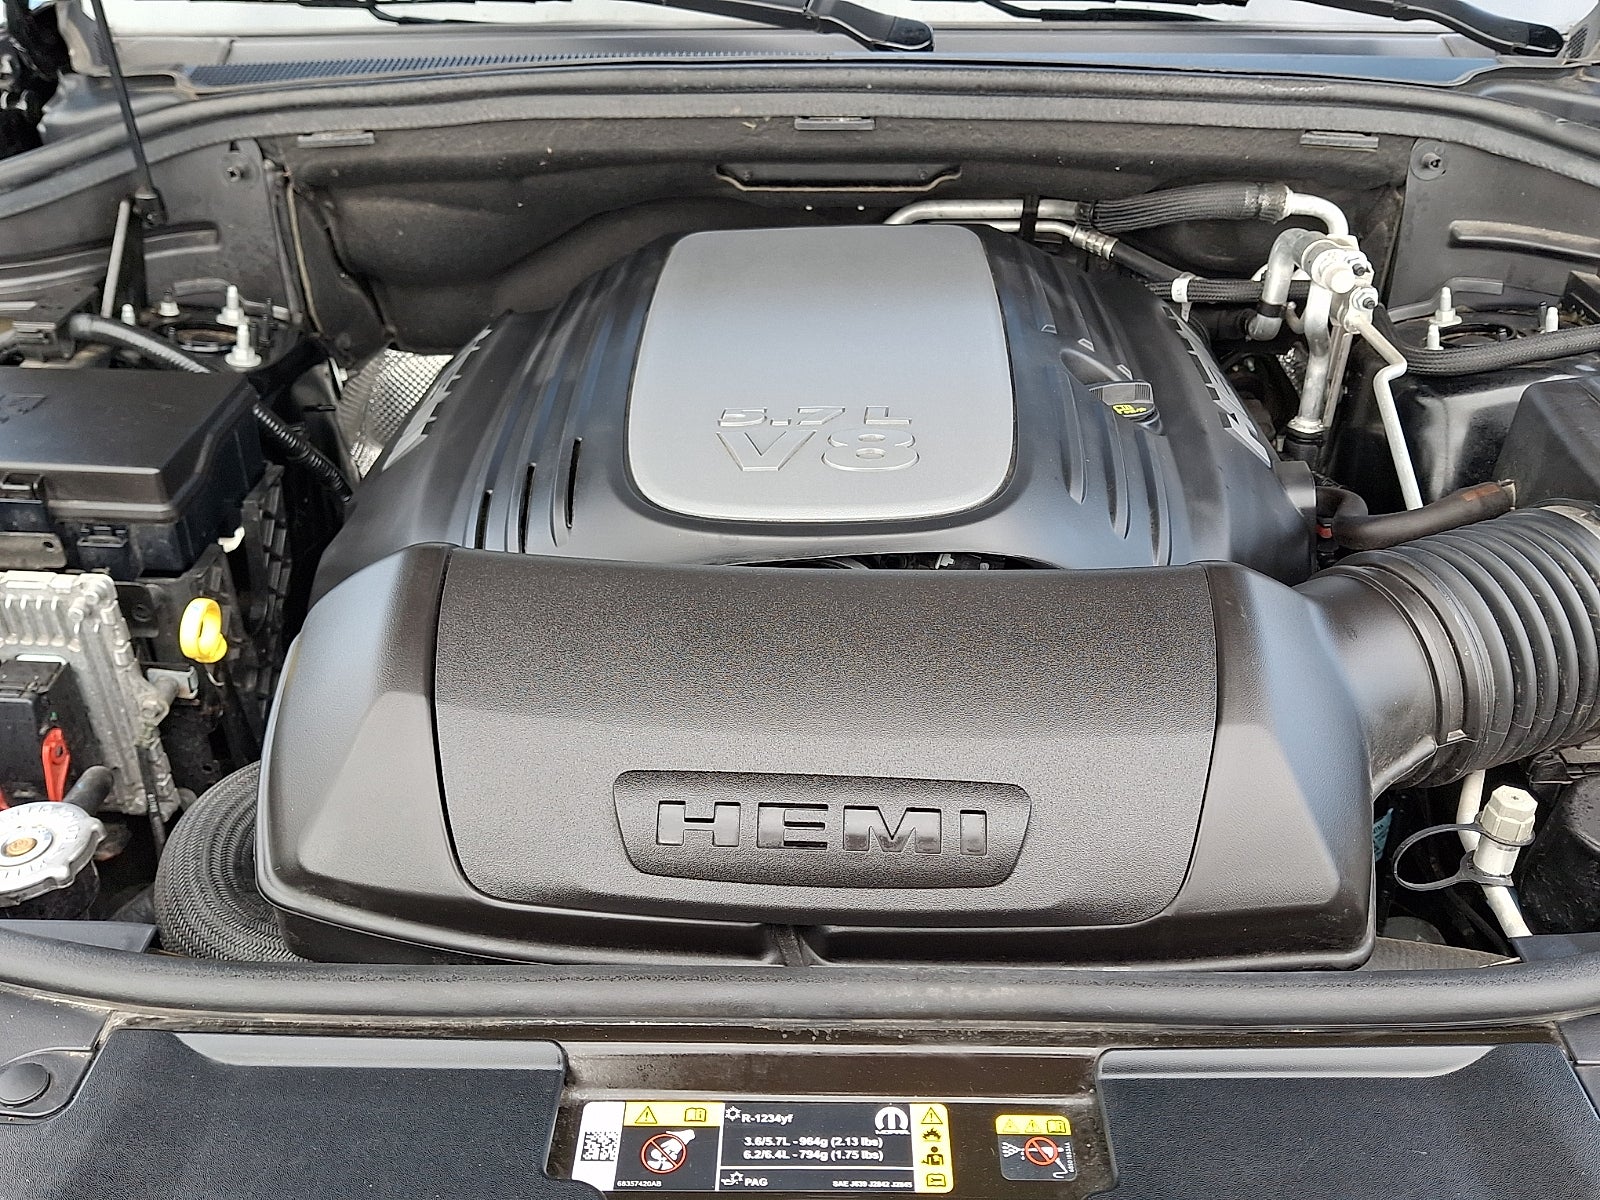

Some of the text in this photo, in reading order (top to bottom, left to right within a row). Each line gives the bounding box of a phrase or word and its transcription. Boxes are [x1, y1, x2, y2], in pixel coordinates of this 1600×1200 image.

[717, 406, 845, 427] 5.7
[716, 430, 920, 472] V8
[656, 800, 988, 856] HEMI
[741, 1113, 794, 1126] R-1234yf
[743, 1136, 791, 1147] 3.6/5.7L
[830, 1136, 859, 1149] (2.13
[860, 1136, 884, 1149] lbs)
[742, 1149, 791, 1160] 6.2/6.4L
[799, 1149, 829, 1162] 794g
[830, 1149, 859, 1162] (1.75
[860, 1149, 884, 1162] lbs)
[744, 1177, 769, 1187] PAG
[832, 1180, 850, 1188] SAE
